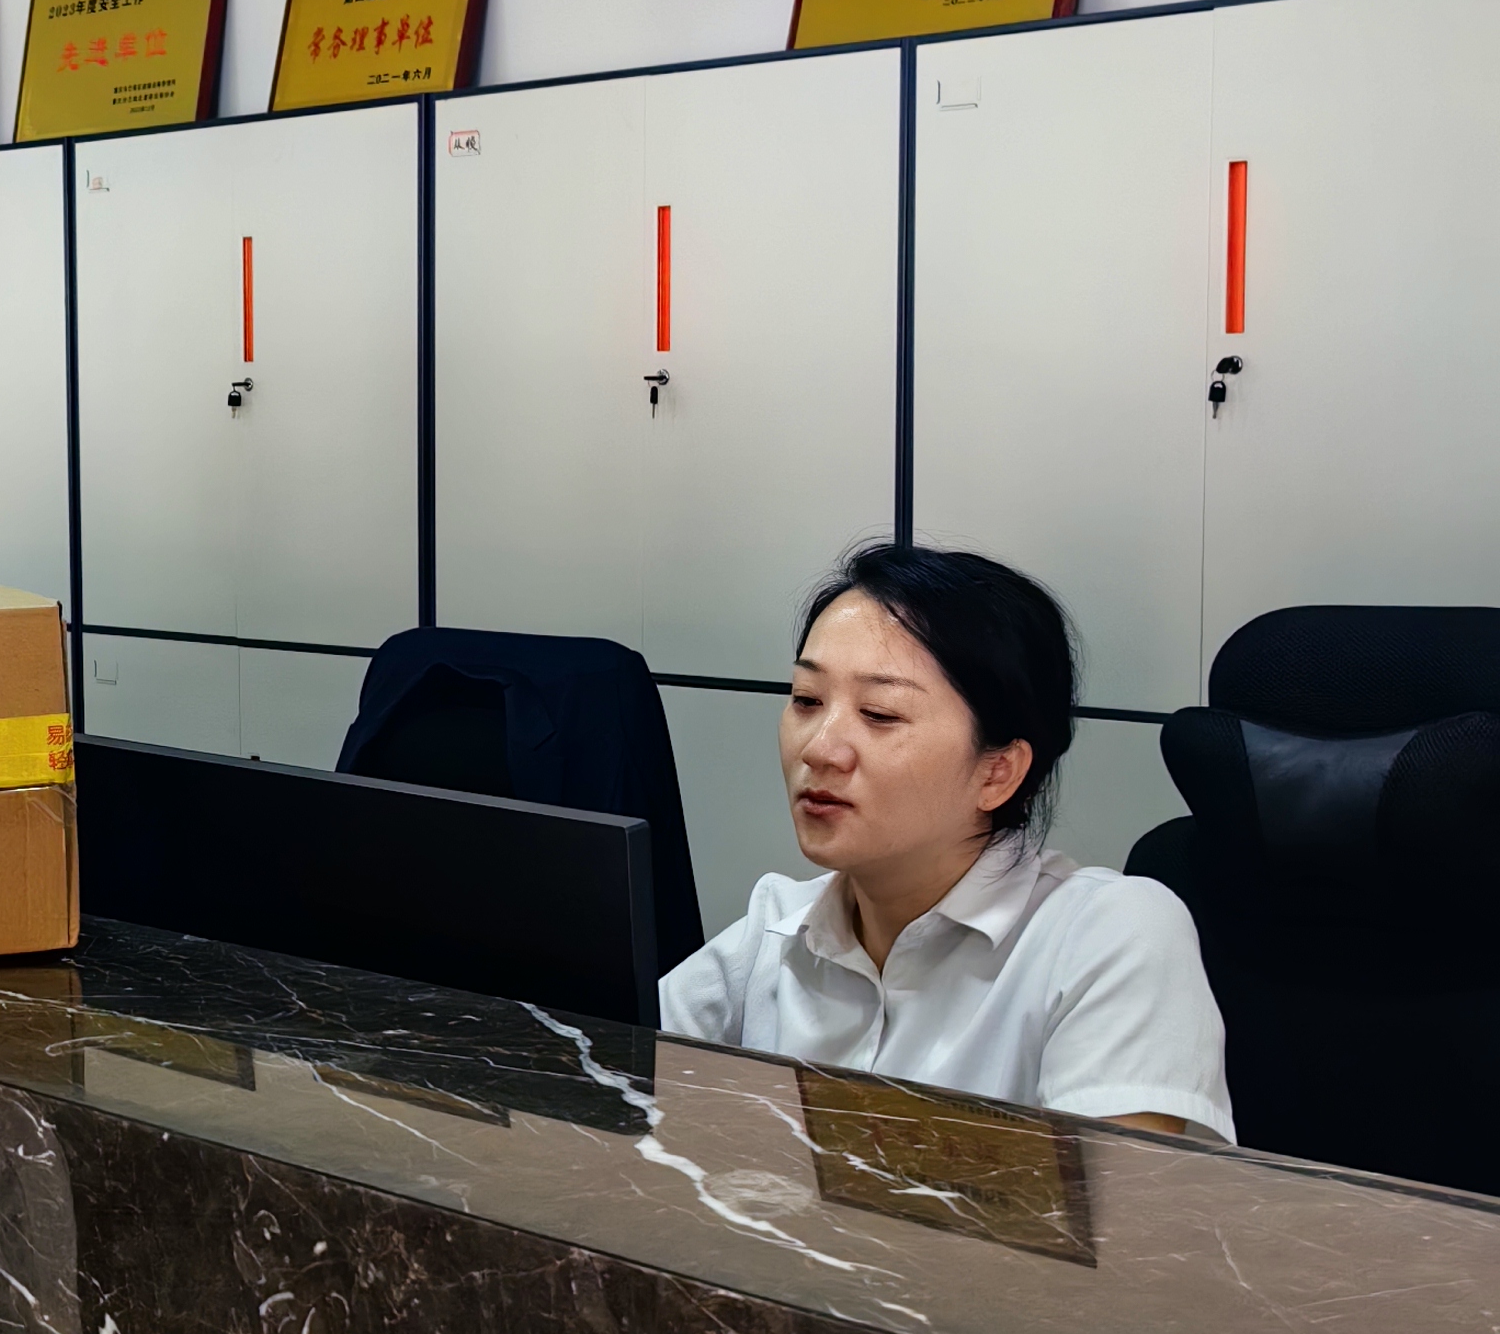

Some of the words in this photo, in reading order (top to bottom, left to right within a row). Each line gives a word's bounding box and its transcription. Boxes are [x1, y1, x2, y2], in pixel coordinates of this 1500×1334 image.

[57, 28, 167, 72] 先进单位
[308, 14, 433, 64] 常务理事单位
